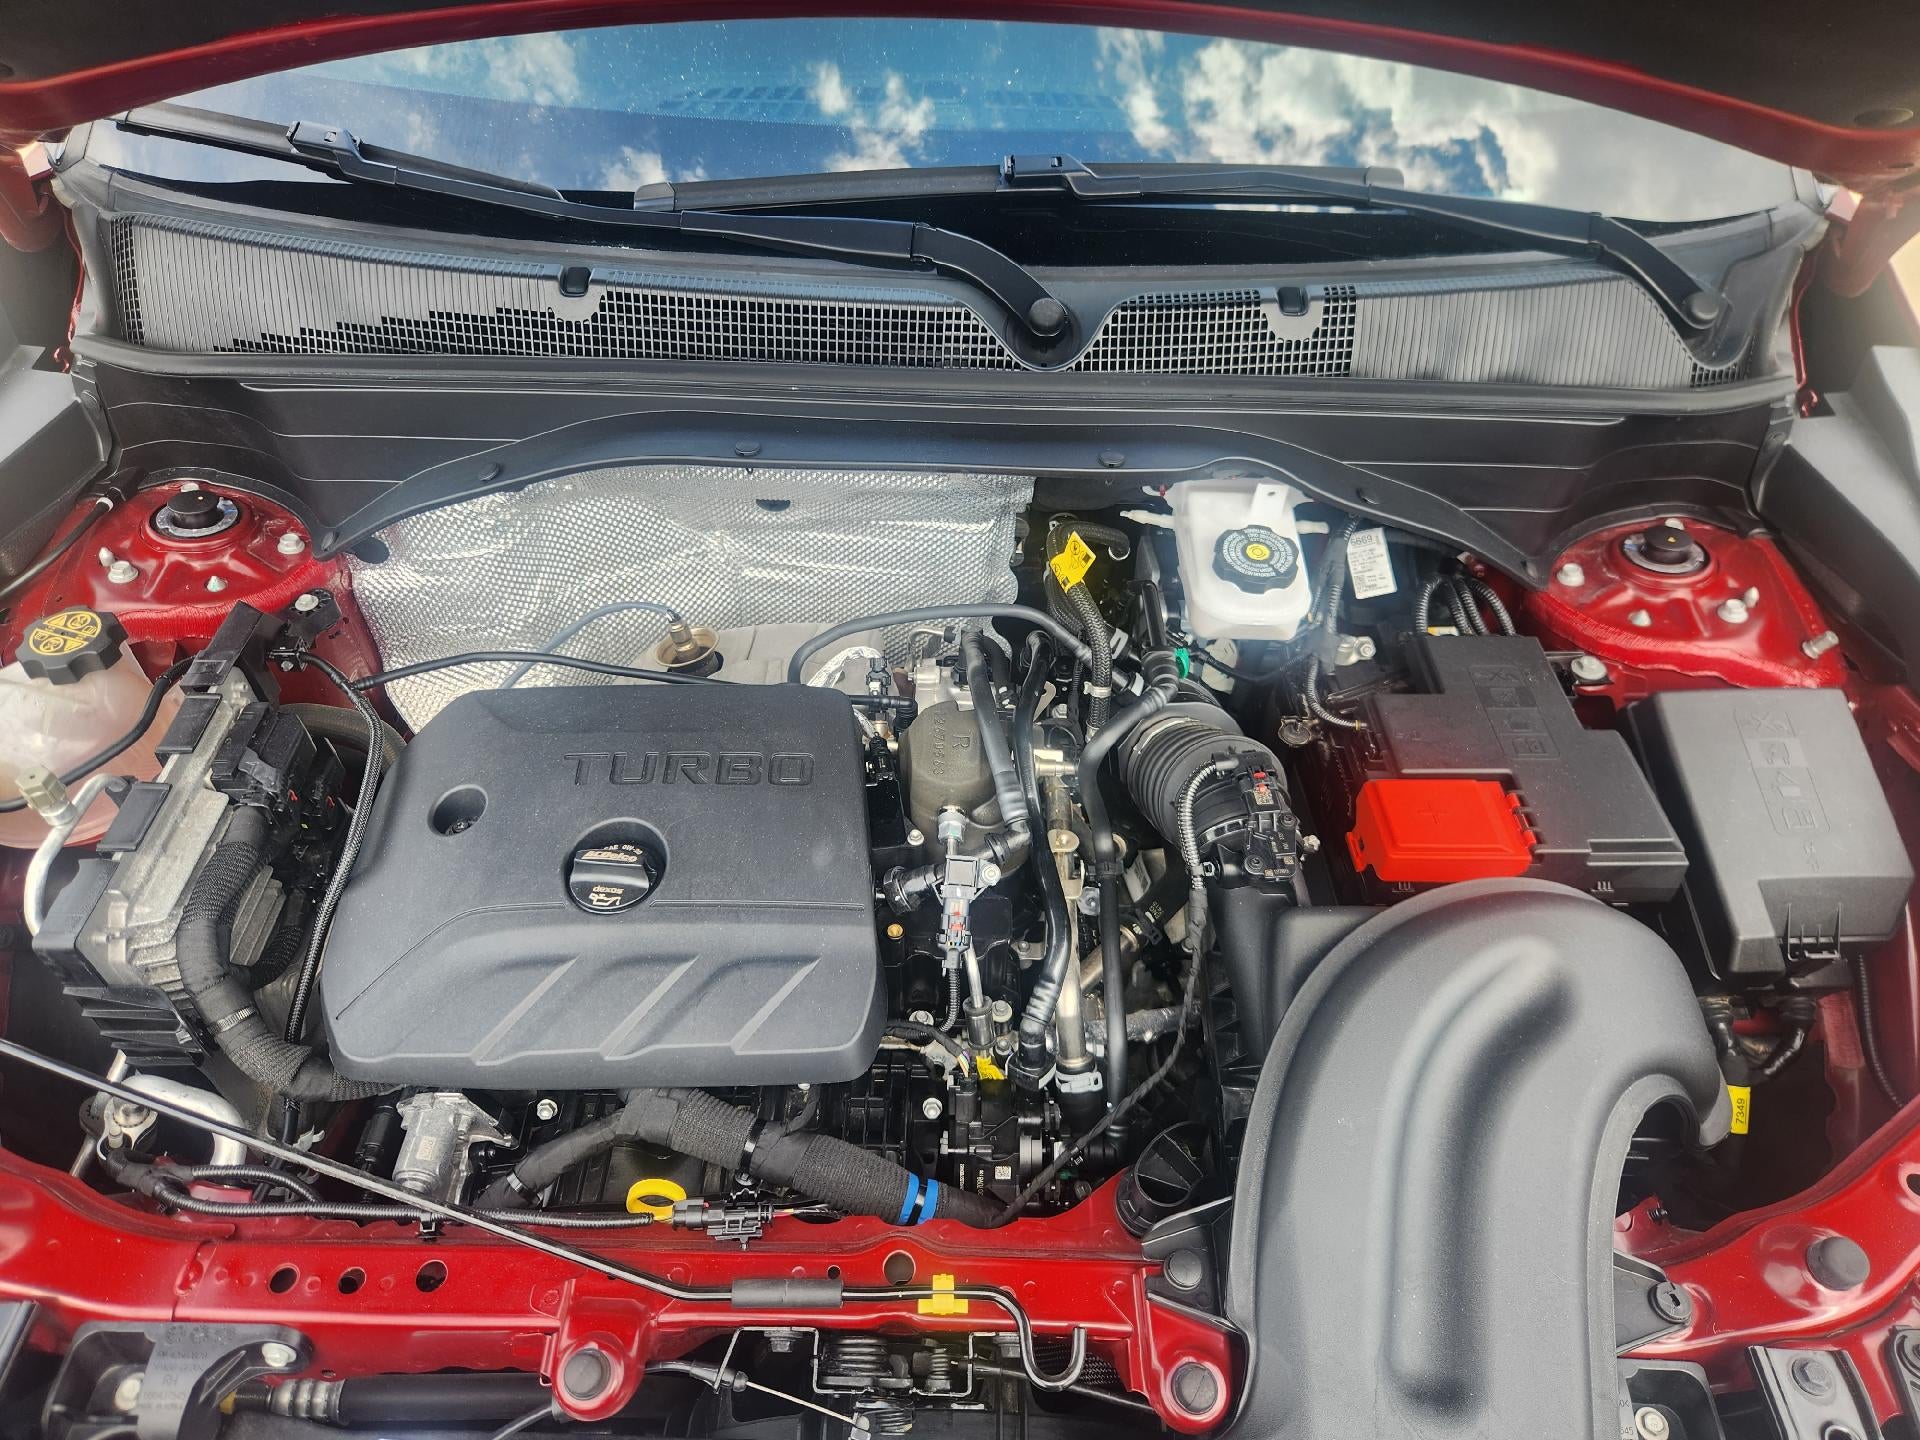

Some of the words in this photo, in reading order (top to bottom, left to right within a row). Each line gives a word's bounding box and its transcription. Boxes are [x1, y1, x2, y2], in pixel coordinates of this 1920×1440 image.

[564, 751, 815, 785] TURBO
[581, 850, 638, 863] ACDelco
[592, 885, 624, 894] dexos
[1736, 1097, 1745, 1124] 7349
